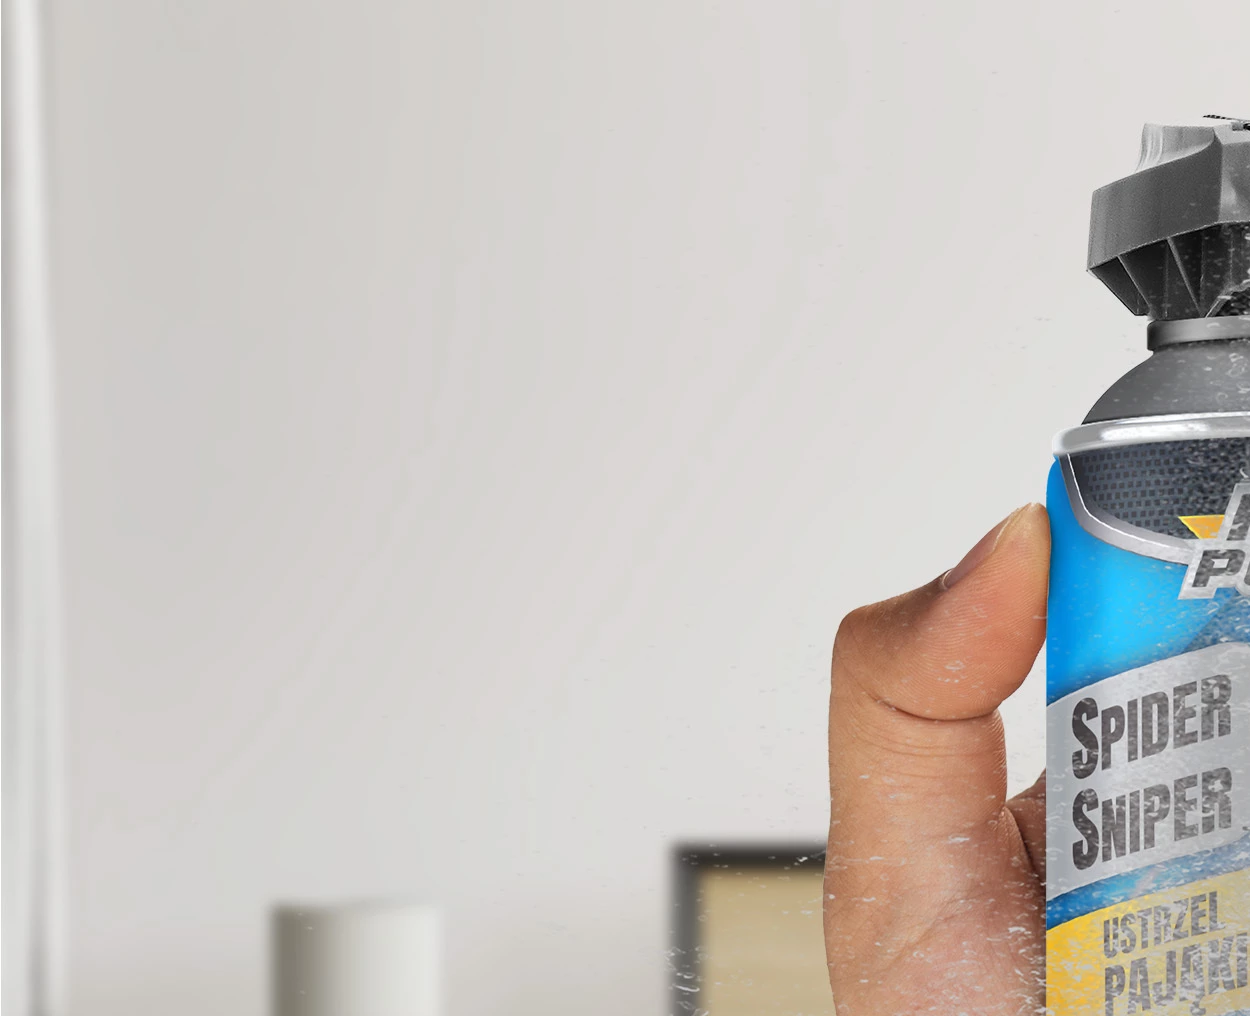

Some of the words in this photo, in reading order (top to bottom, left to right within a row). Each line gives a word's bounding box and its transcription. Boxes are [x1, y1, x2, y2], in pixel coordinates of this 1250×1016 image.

[1072, 674, 1232, 779] SPIDER
[1072, 767, 1232, 870] SNIPER
[1103, 891, 1225, 958] USTRZEL
